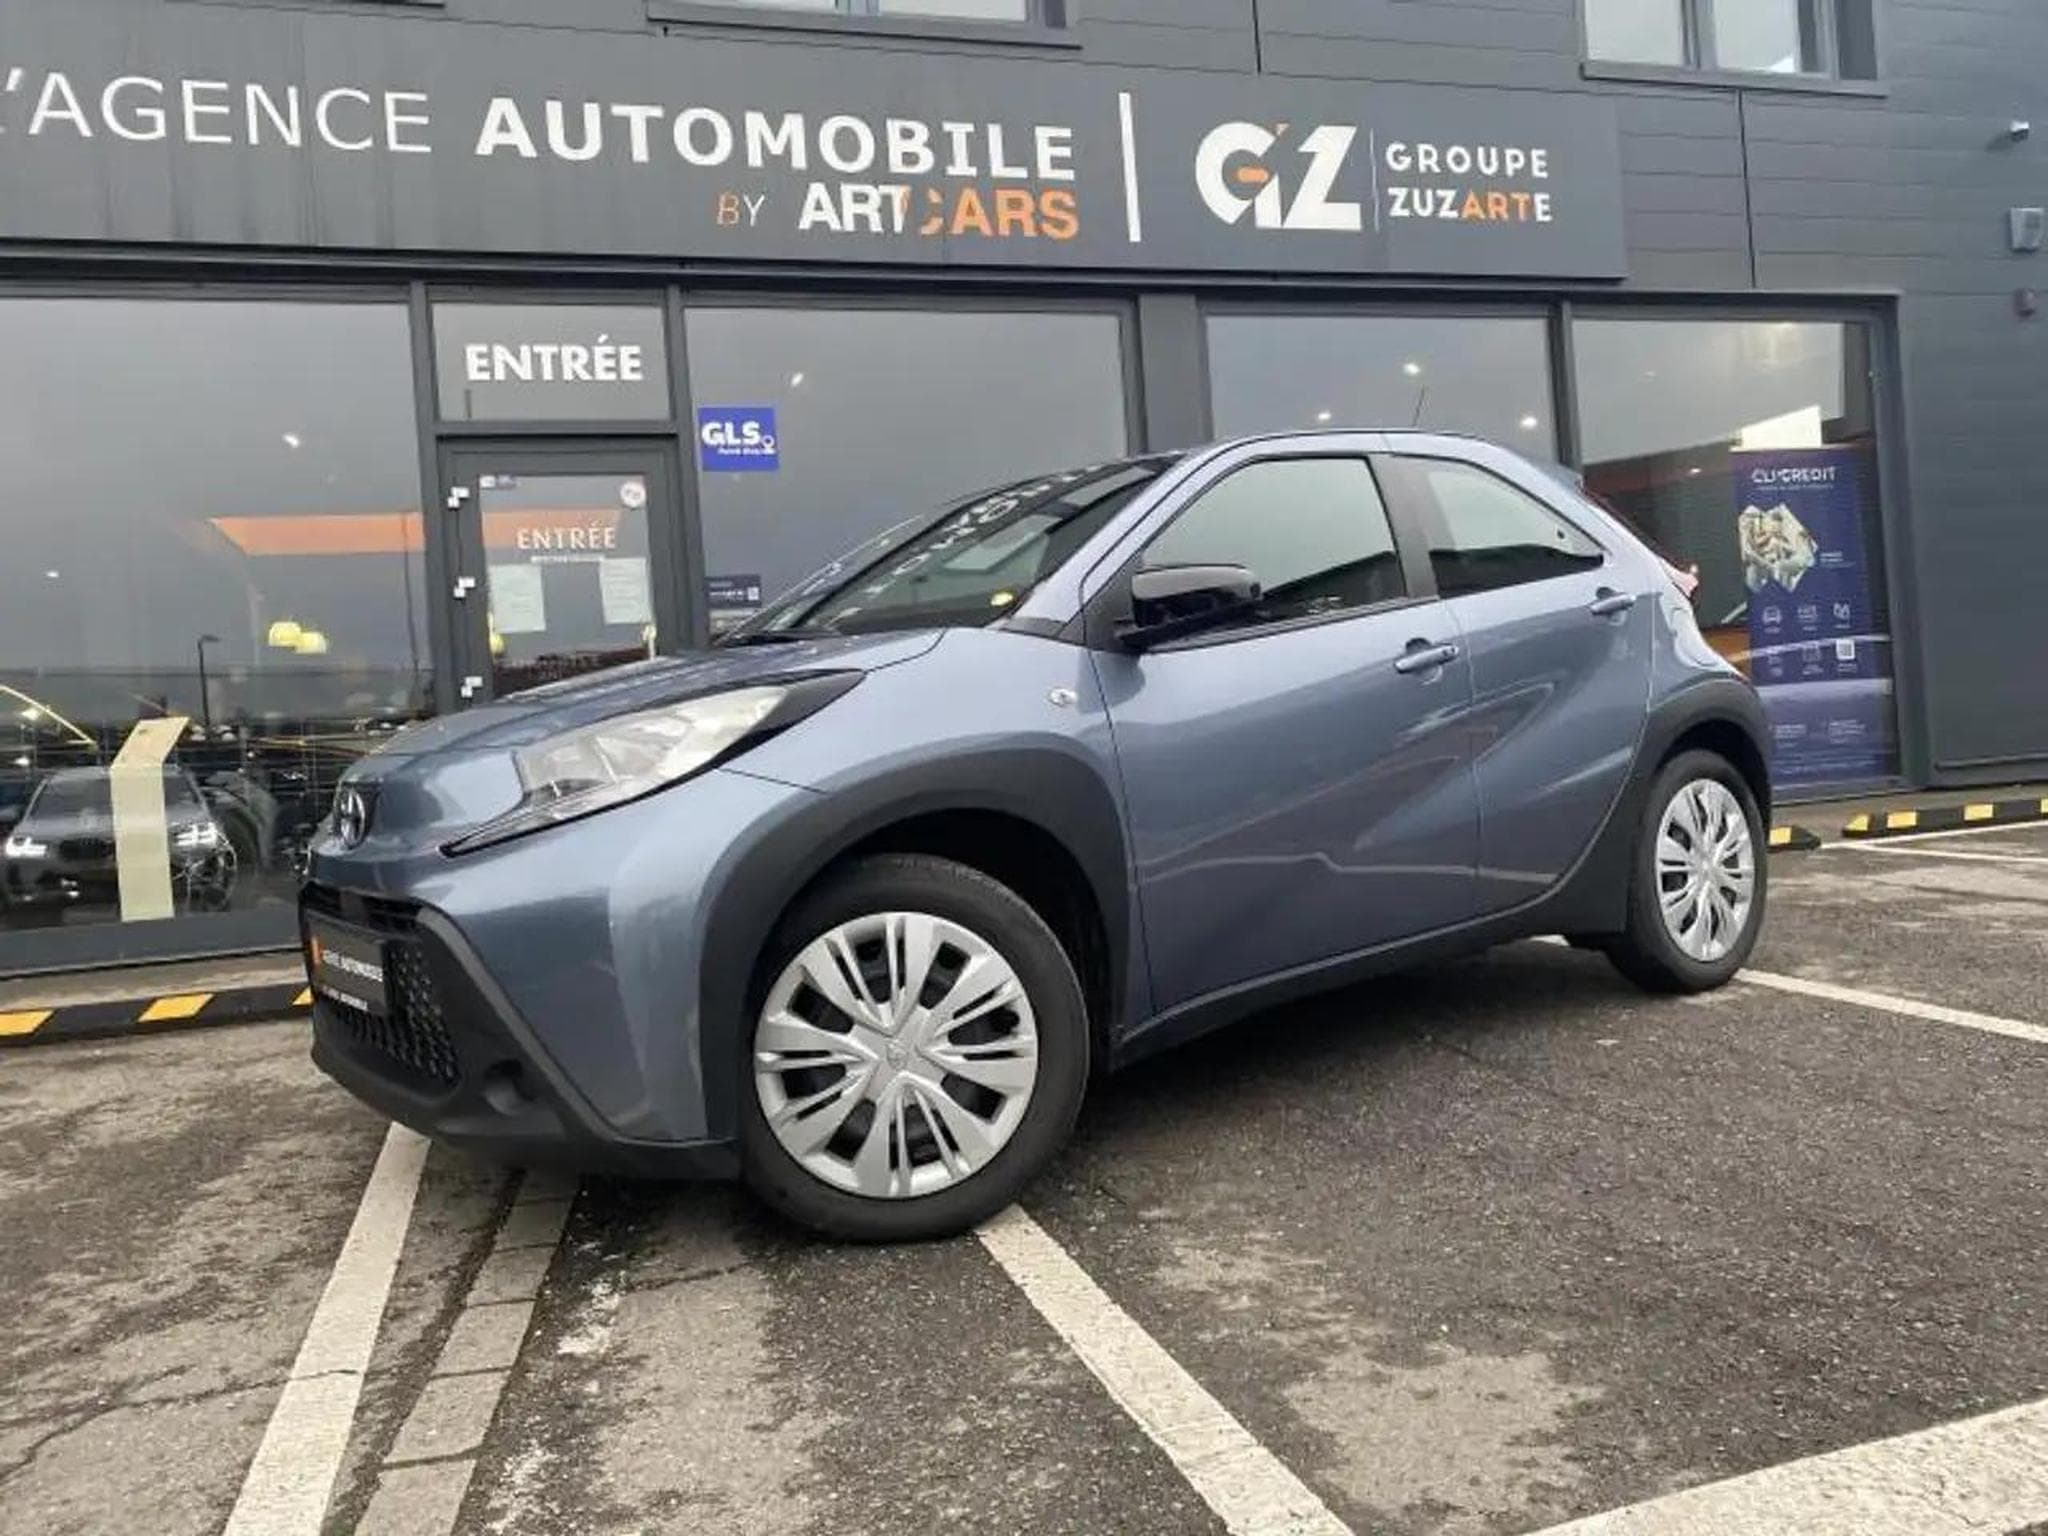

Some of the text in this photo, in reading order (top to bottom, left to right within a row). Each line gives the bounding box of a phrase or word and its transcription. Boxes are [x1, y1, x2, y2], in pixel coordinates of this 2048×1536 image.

[0, 67, 1076, 181] 'AGENCE AUTOMOBILE
[1385, 142, 1549, 179] GROUPE
[715, 192, 766, 227] BY
[1387, 186, 1554, 223] ZUZARTE
[464, 333, 644, 382] ENTRÉE
[700, 420, 761, 447] GLS
[516, 519, 617, 551] ENTRÉE
